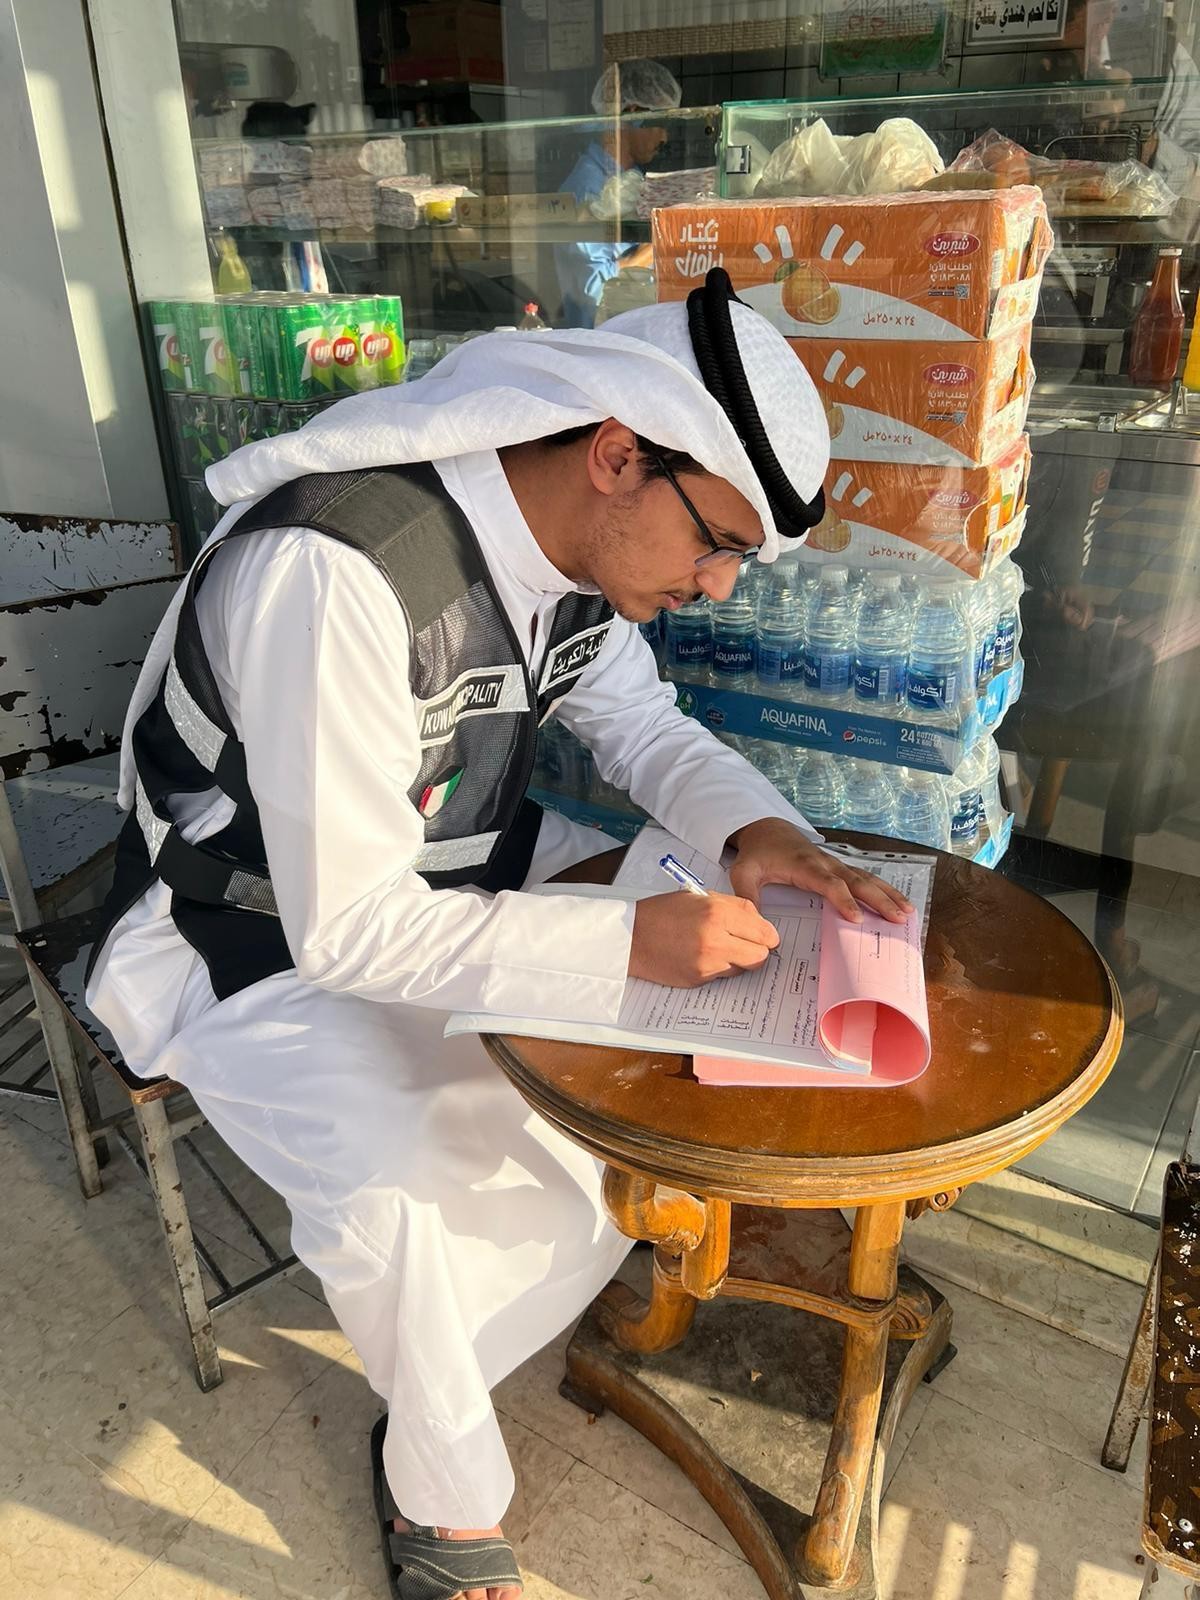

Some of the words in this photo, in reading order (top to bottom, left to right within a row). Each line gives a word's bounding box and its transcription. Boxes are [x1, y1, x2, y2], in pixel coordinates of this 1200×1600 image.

[932, 234, 970, 254] شيرين
[946, 262, 972, 272] اطلب
[931, 367, 969, 384] شيرين
[552, 642, 586, 675] الكويت
[714, 651, 752, 664] AQUAFINA
[760, 707, 828, 735] AQUAFINA
[856, 735, 882, 747] pepsi
[900, 728, 915, 744] 24
